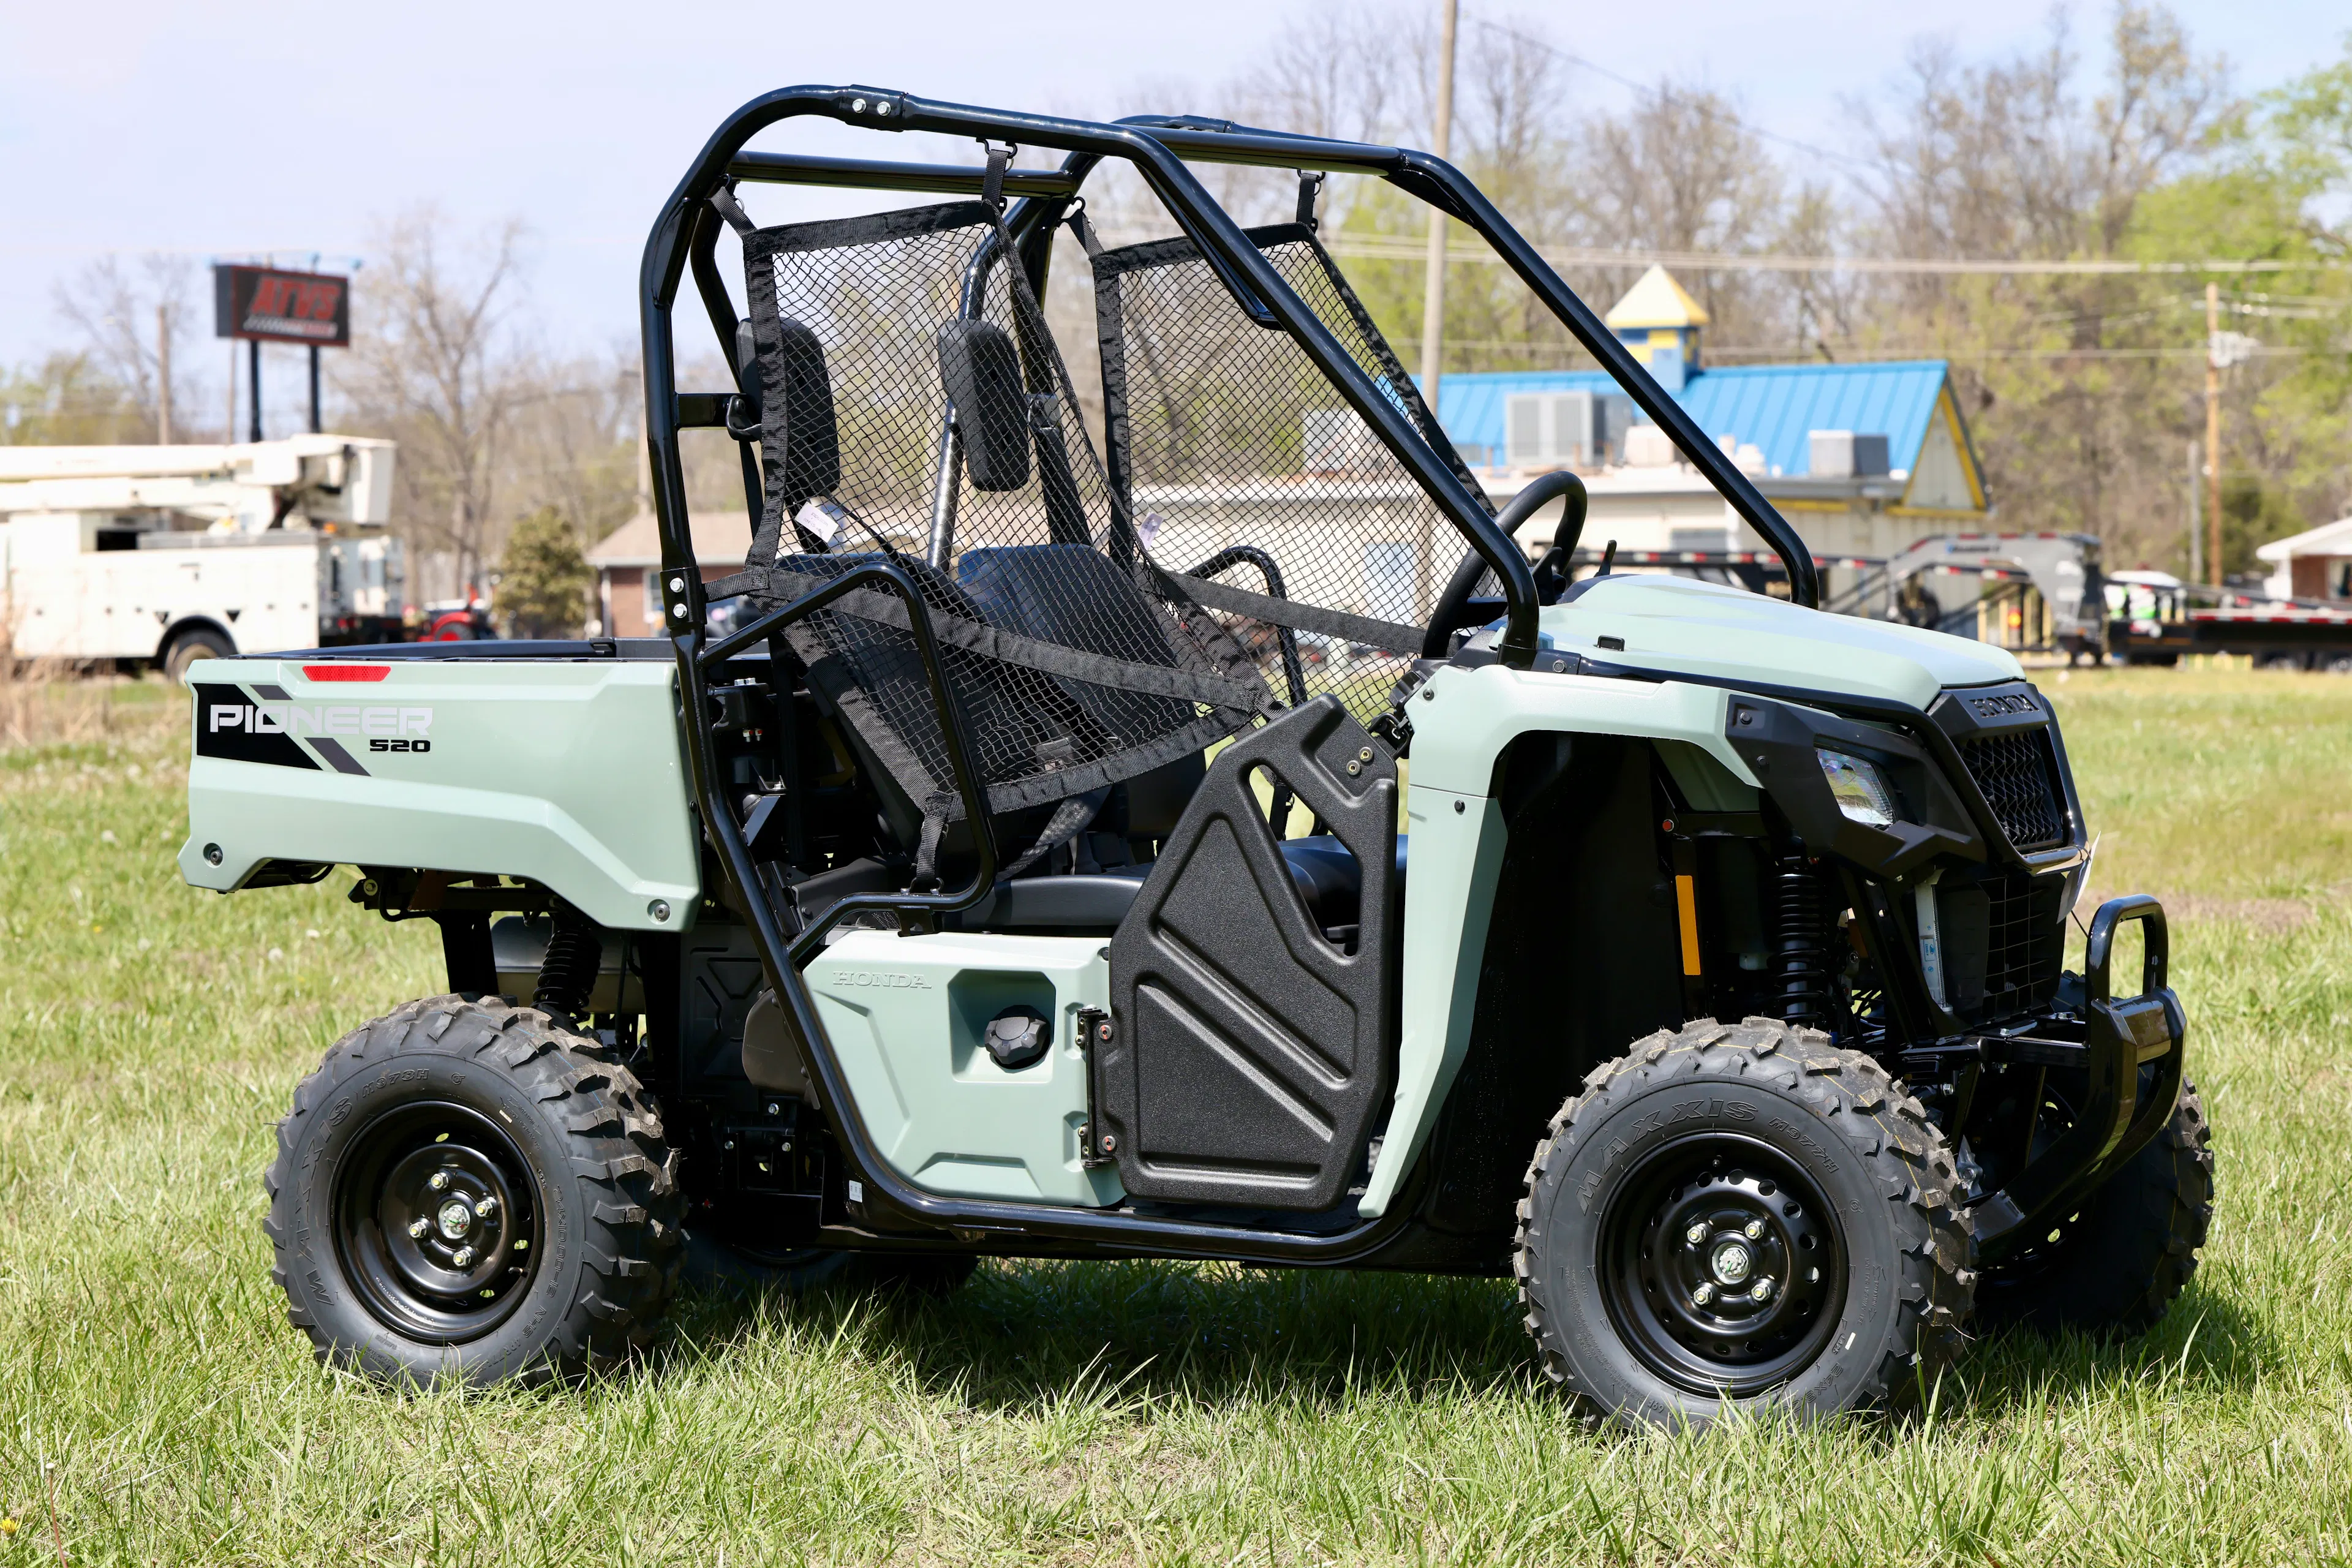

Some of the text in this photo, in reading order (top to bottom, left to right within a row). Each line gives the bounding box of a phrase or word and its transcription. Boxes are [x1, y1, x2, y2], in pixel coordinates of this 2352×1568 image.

[210, 704, 433, 736] PIONEER
[1969, 693, 2040, 718] HONDA
[369, 739, 431, 753] 520
[832, 971, 932, 989] HONDA
[363, 1068, 429, 1098] M978H
[519, 1106, 535, 1125] ROTATION
[1575, 1099, 1759, 1216] MAXXIS
[1768, 1117, 1839, 1174] M977H
[295, 1096, 352, 1305] MAXXIS
[546, 1184, 567, 1297] 24X10.00-12
[522, 1305, 546, 1338] NHS
